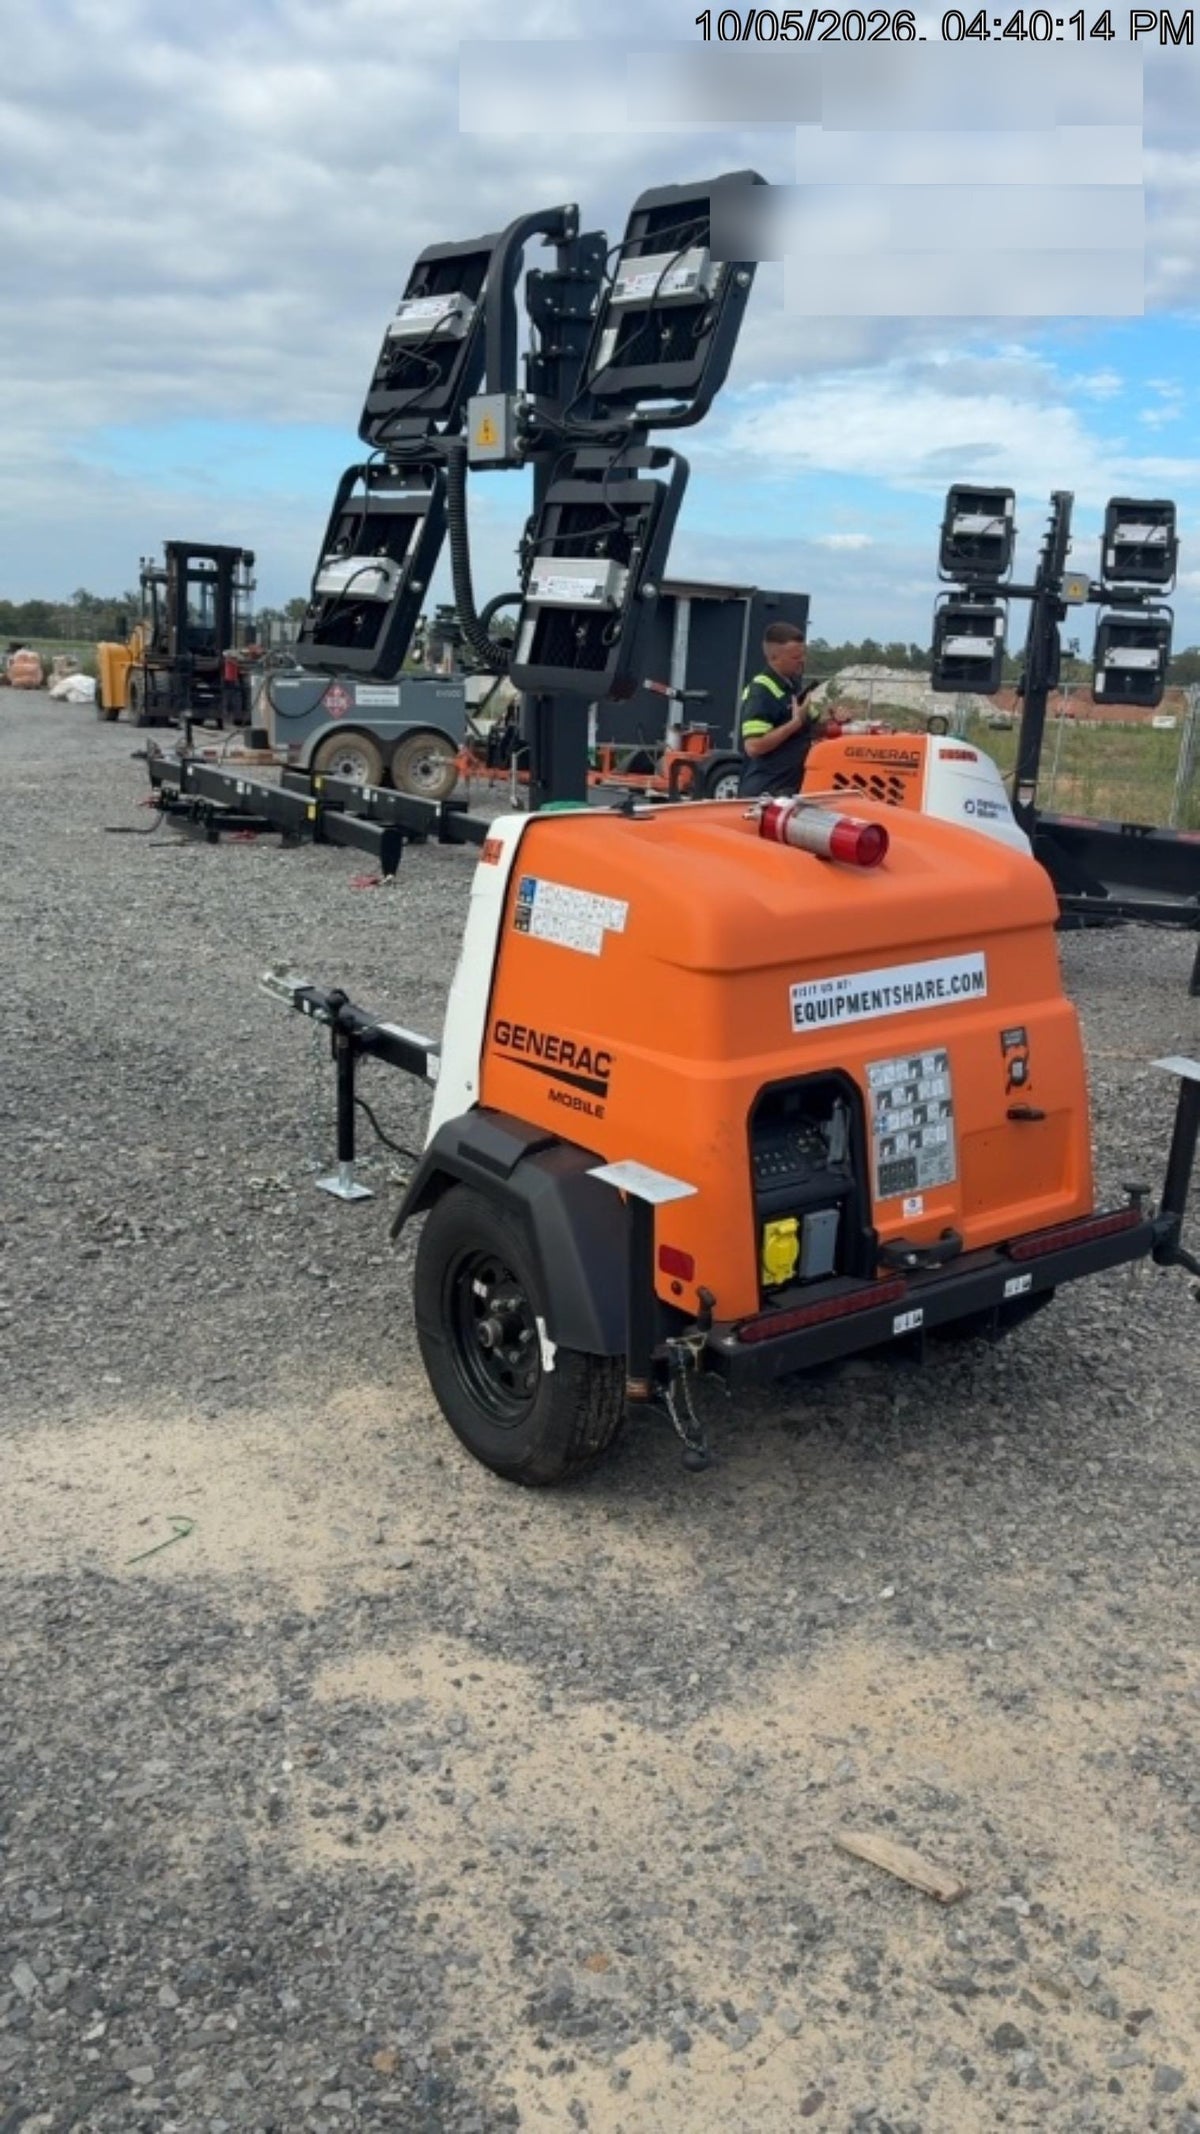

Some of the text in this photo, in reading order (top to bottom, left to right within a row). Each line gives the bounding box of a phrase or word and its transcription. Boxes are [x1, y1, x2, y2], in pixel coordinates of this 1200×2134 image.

[844, 746, 921, 761] GENERAC
[794, 970, 985, 1025] EQUIPMENTSHARE.COM
[494, 1020, 612, 1079] GENERAC
[547, 1087, 606, 1120] MOBILE
